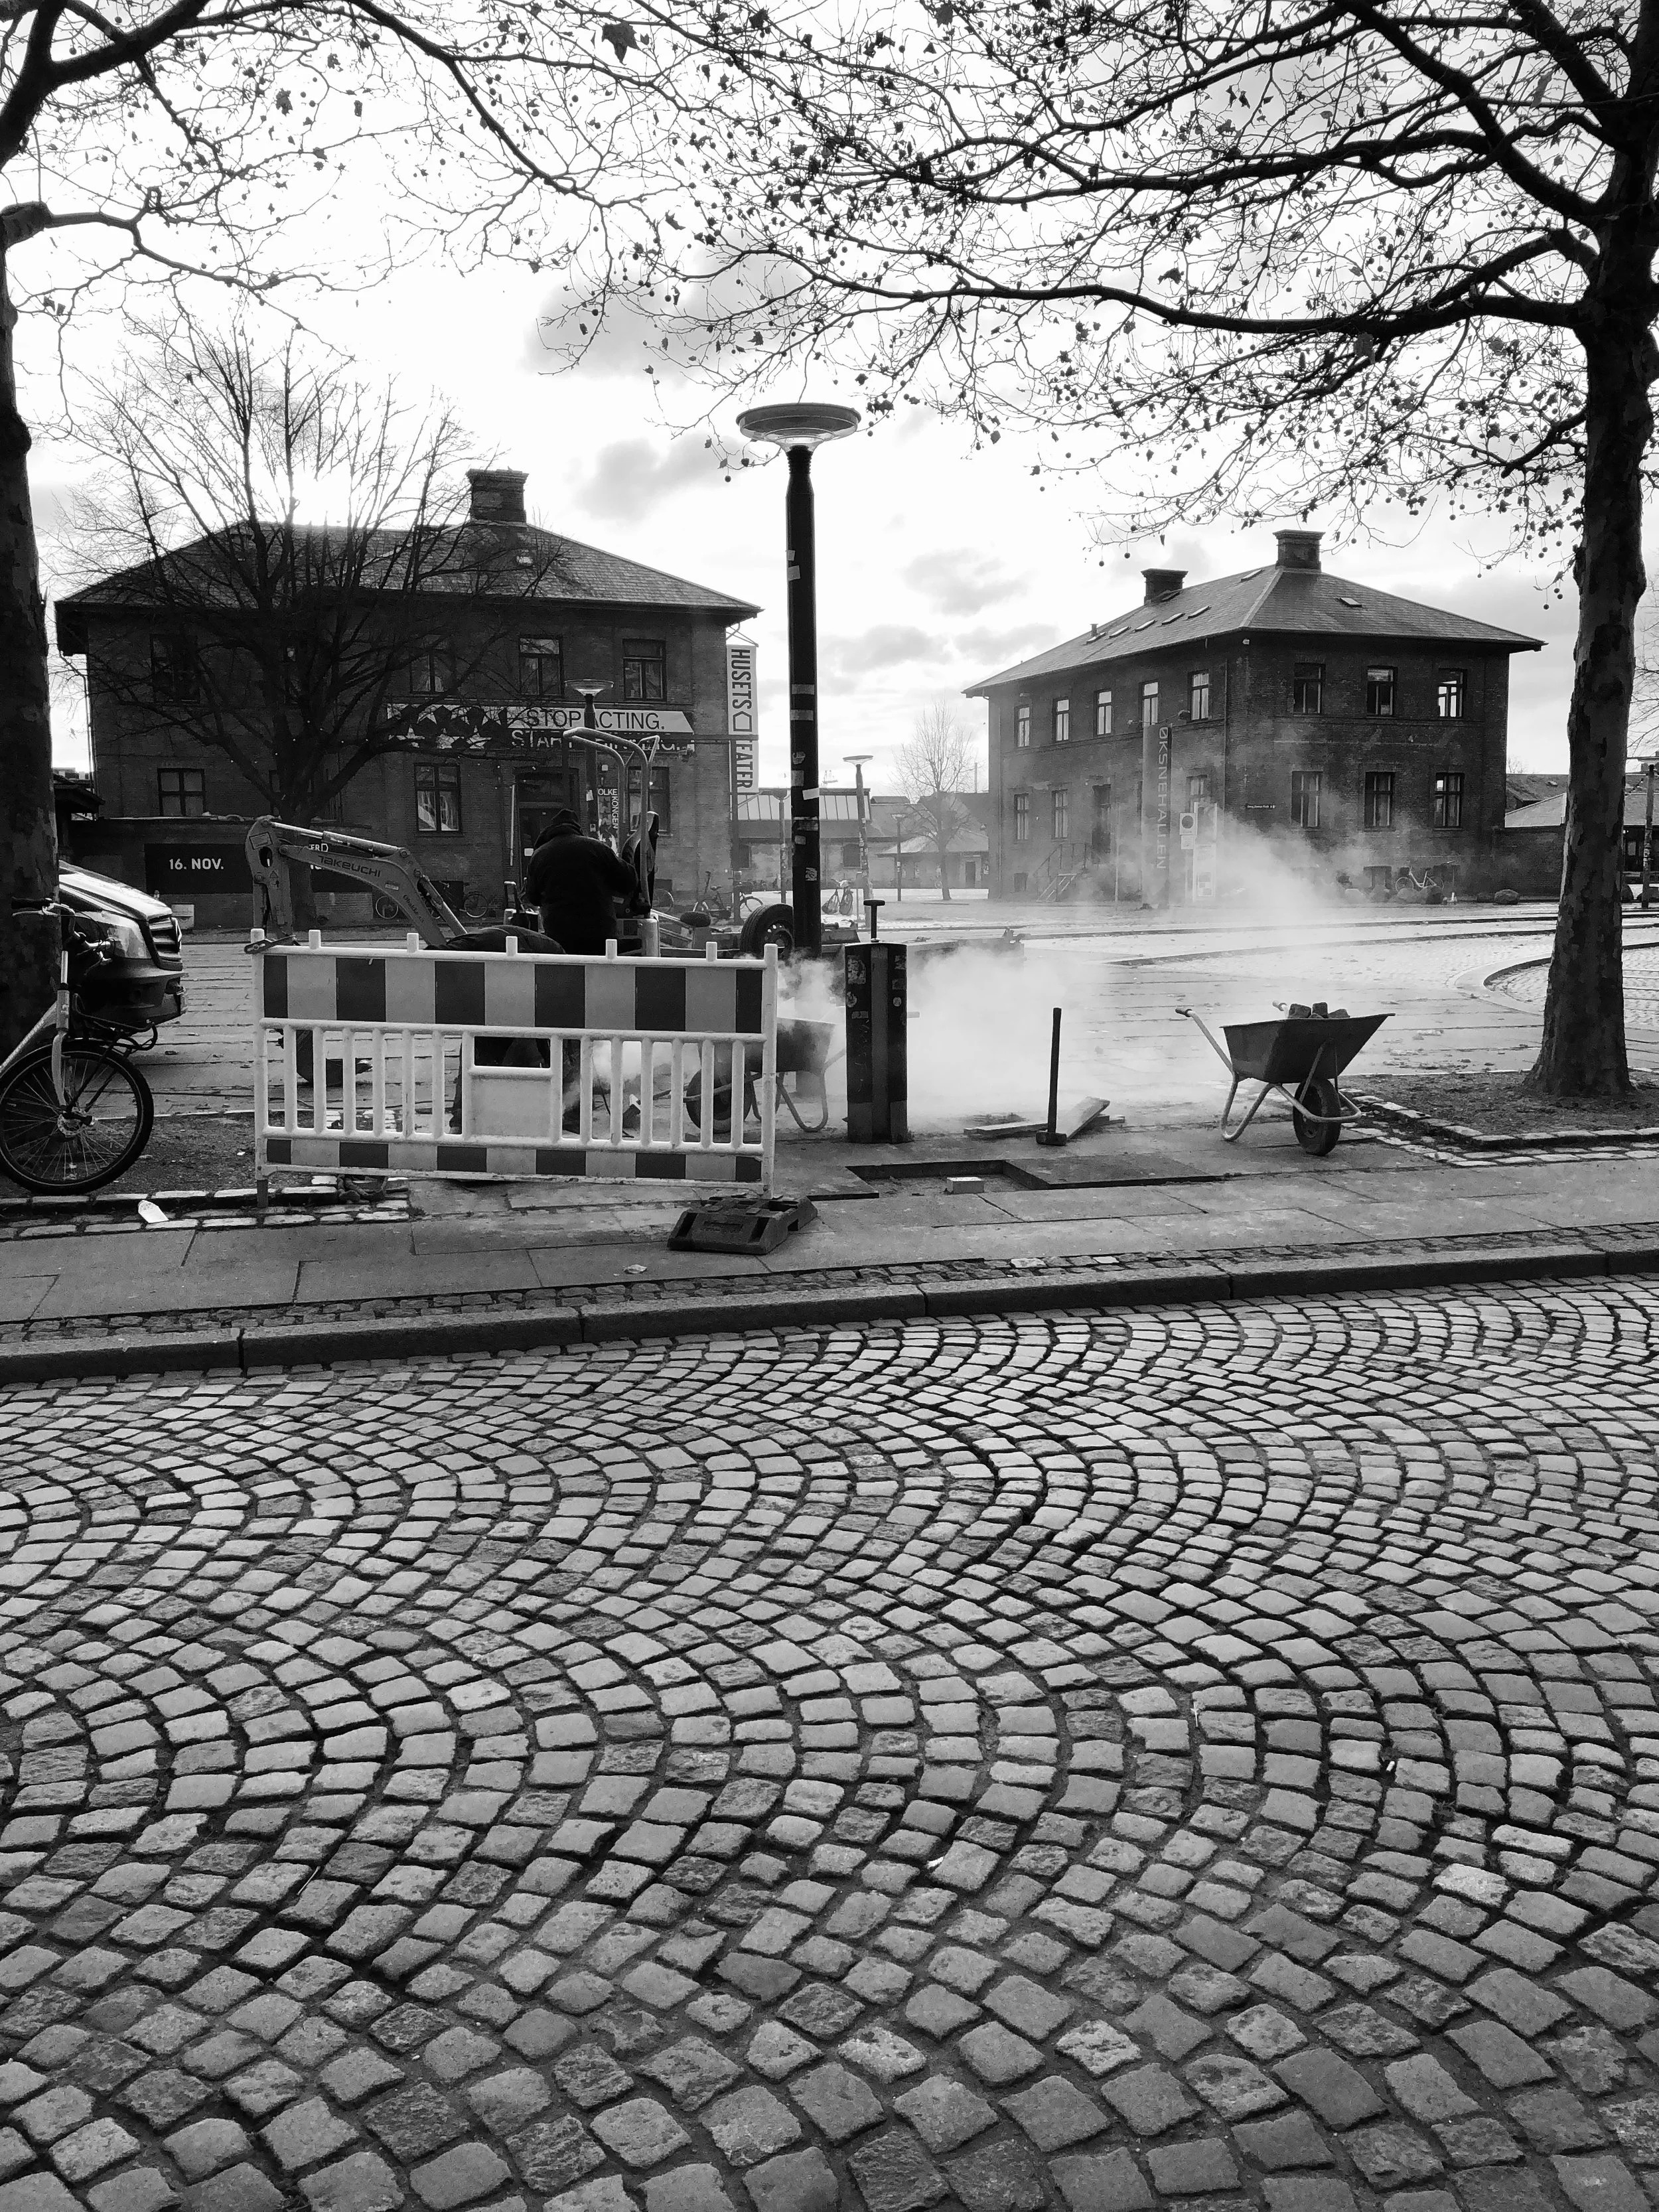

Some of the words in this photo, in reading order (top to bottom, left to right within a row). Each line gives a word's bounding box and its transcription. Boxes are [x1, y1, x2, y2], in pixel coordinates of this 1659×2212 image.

[731, 648, 752, 709] HUSETS
[527, 708, 581, 728] STOP
[595, 710, 665, 730] CTING.
[511, 730, 573, 749] STAR
[736, 734, 753, 789] EATER
[1157, 727, 1169, 869] ØKSNEHALLEN
[169, 858, 187, 870] 16.
[191, 858, 224, 870] NOV.
